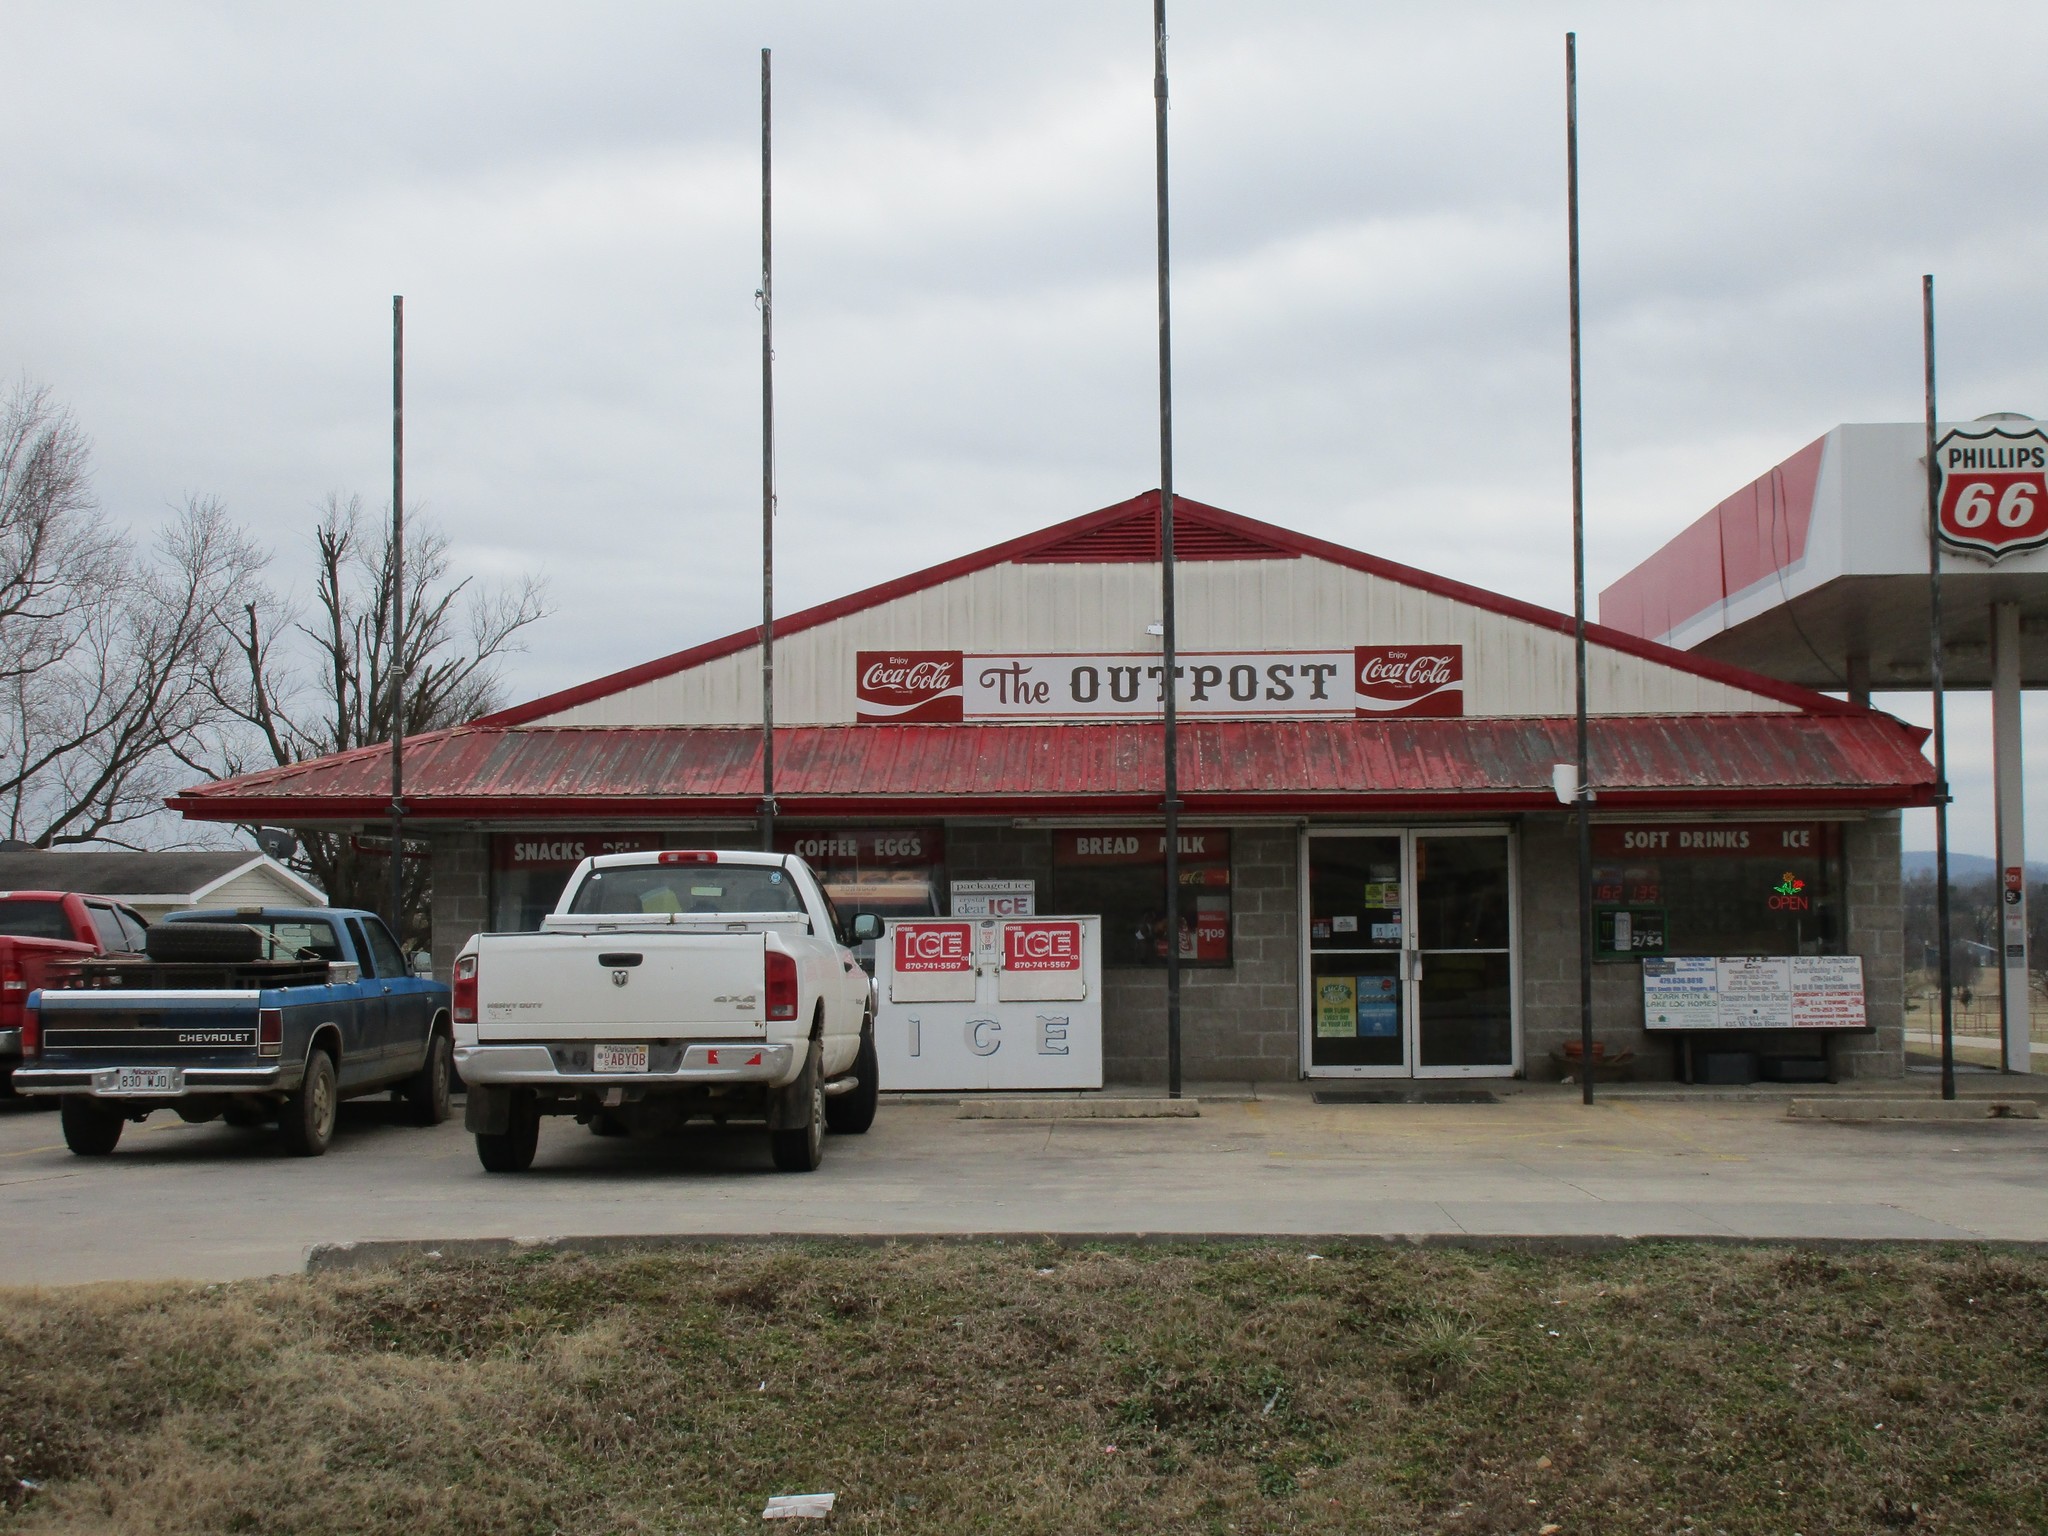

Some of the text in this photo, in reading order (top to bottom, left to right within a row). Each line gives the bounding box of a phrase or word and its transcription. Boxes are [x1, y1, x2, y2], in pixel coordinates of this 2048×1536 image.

[1949, 446, 2045, 468] PHILLIPS
[1954, 482, 2038, 528] 66
[890, 656, 908, 665] Enjoy
[1388, 652, 1408, 660] Enjoy
[862, 662, 954, 690] Coca-Cola
[1361, 656, 1454, 684] Coca-Cola
[980, 662, 1337, 704] The OUTPOST
[794, 838, 921, 857] COFFEE EGGS
[1076, 836, 1140, 855] BREAD
[1624, 830, 1810, 848] SOFT DRINKS ICE
[514, 842, 586, 861] SNACKS
[956, 882, 1010, 890] packaged
[1597, 885, 1622, 899] 162
[958, 903, 986, 914] clear
[988, 898, 1028, 914] ICE
[1768, 896, 1808, 910] OPEN
[1198, 928, 1225, 942] $109
[1632, 936, 1663, 947] 2/$4
[905, 931, 962, 958] ICE
[1014, 930, 1071, 958] ICE
[905, 962, 962, 970] 870-741-5567
[178, 1033, 250, 1042] CHEVROLET
[908, 1012, 1070, 1057] ICE
[122, 1076, 141, 1087] 830
